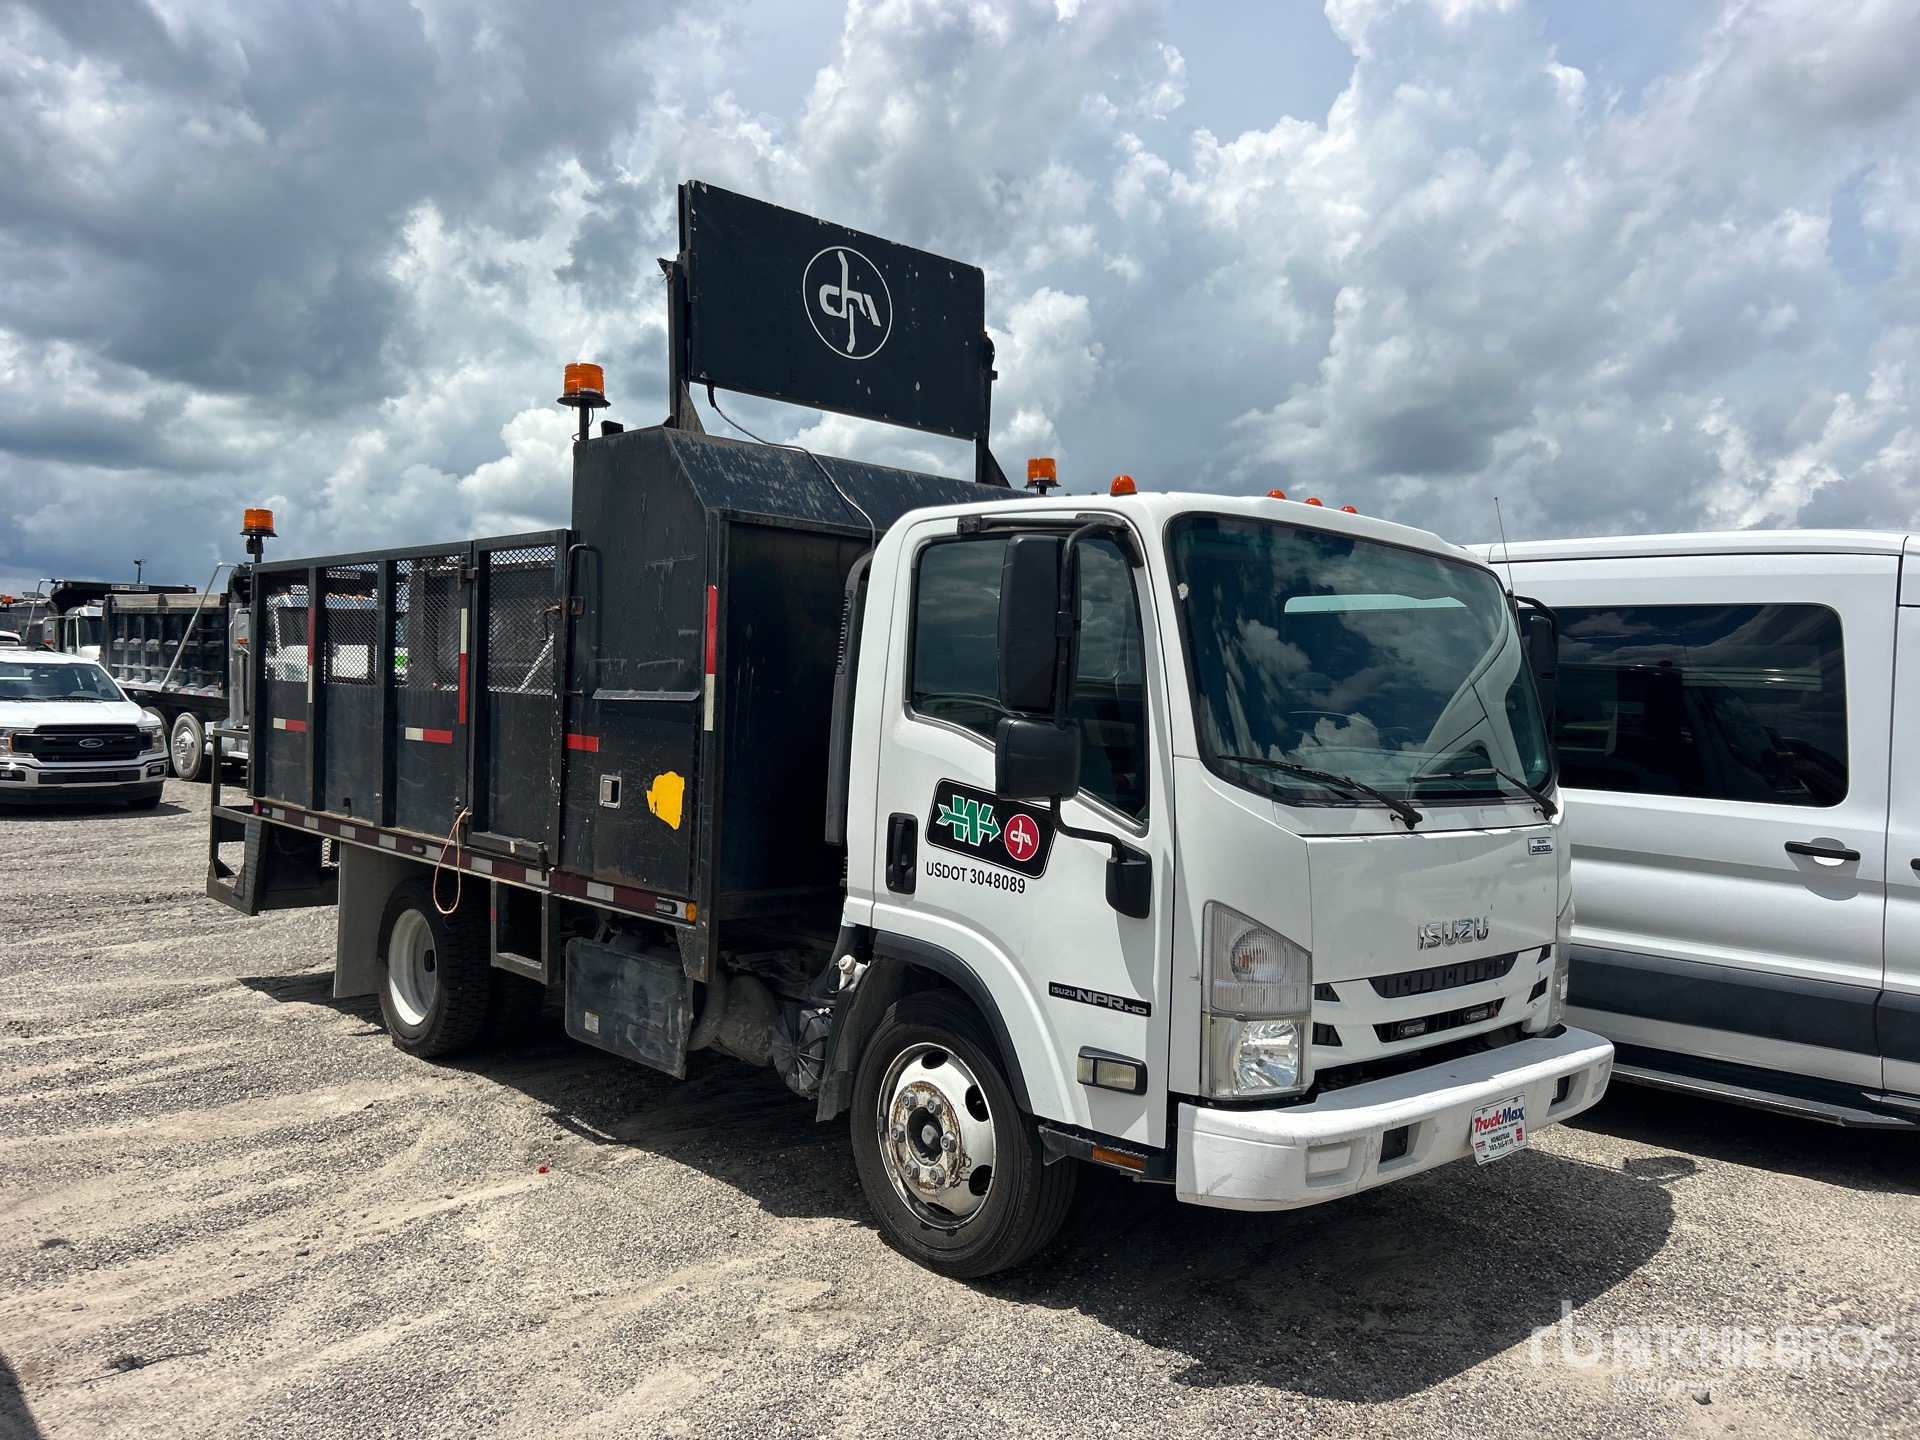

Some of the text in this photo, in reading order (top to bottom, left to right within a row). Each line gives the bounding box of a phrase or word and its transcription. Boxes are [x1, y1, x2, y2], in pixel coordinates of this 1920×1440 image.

[926, 861, 1026, 894] USDOT 3048089
[1417, 916, 1489, 951] ISUZU
[1051, 986, 1076, 997] ISUZU
[1475, 1106, 1525, 1133] TruckMax
